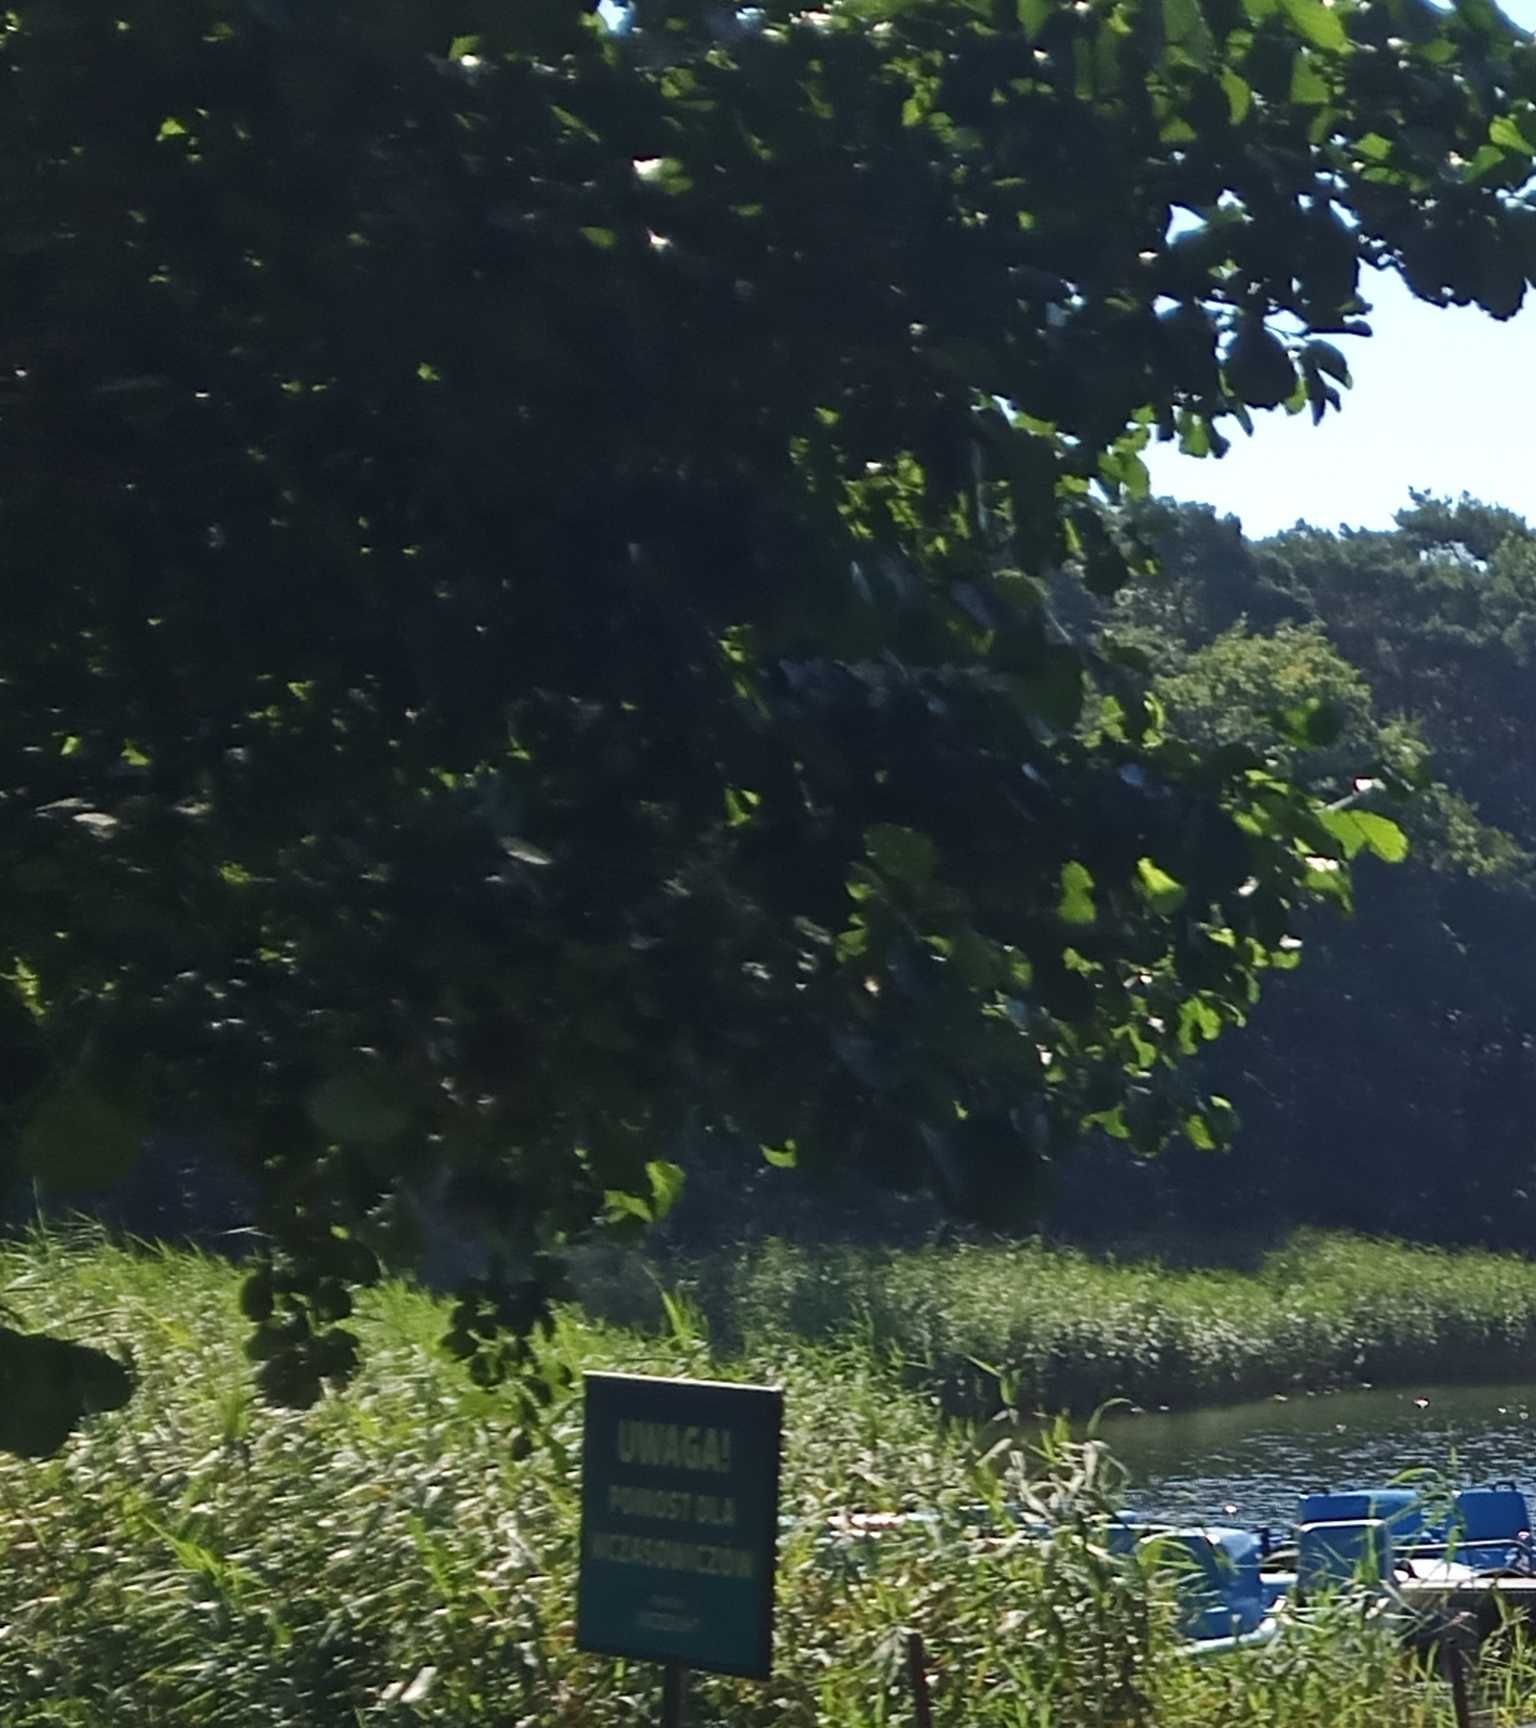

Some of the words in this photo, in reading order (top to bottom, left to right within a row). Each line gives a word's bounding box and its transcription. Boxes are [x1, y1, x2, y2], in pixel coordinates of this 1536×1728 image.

[618, 1418, 732, 1473] UWAGA!
[608, 1484, 691, 1521] POMOST
[696, 1494, 737, 1527] DLA
